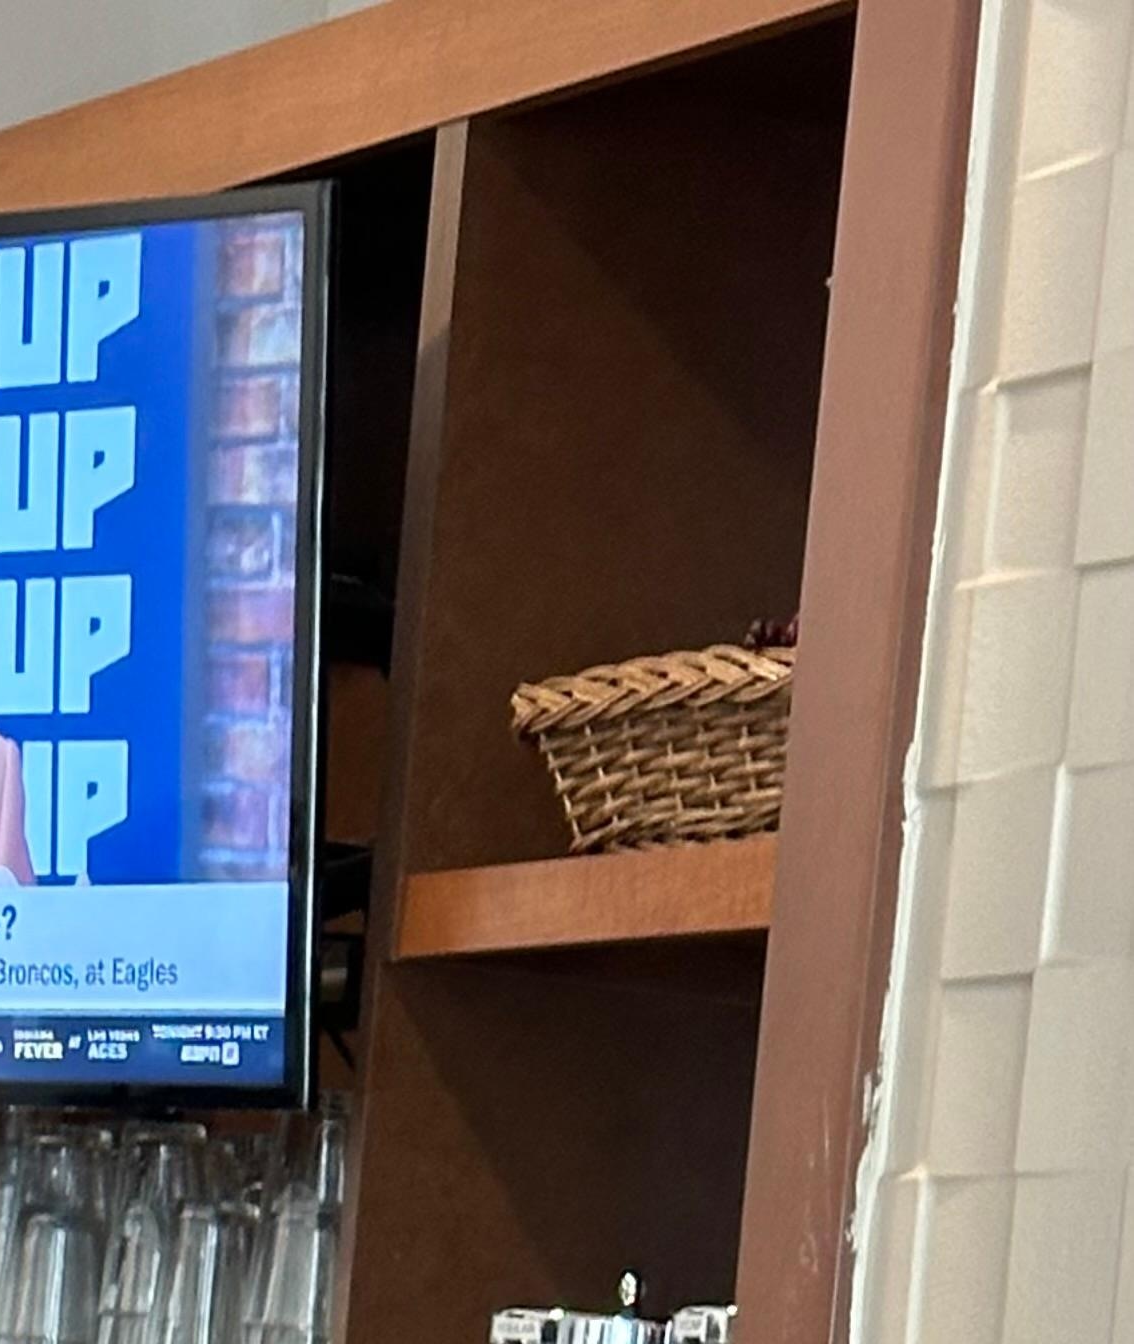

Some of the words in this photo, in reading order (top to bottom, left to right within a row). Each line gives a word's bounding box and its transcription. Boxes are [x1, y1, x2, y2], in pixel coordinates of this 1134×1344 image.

[85, 960, 106, 985] at
[112, 957, 178, 992] Eagles
[14, 1042, 64, 1060] FEVER
[88, 1043, 129, 1060] ACES
